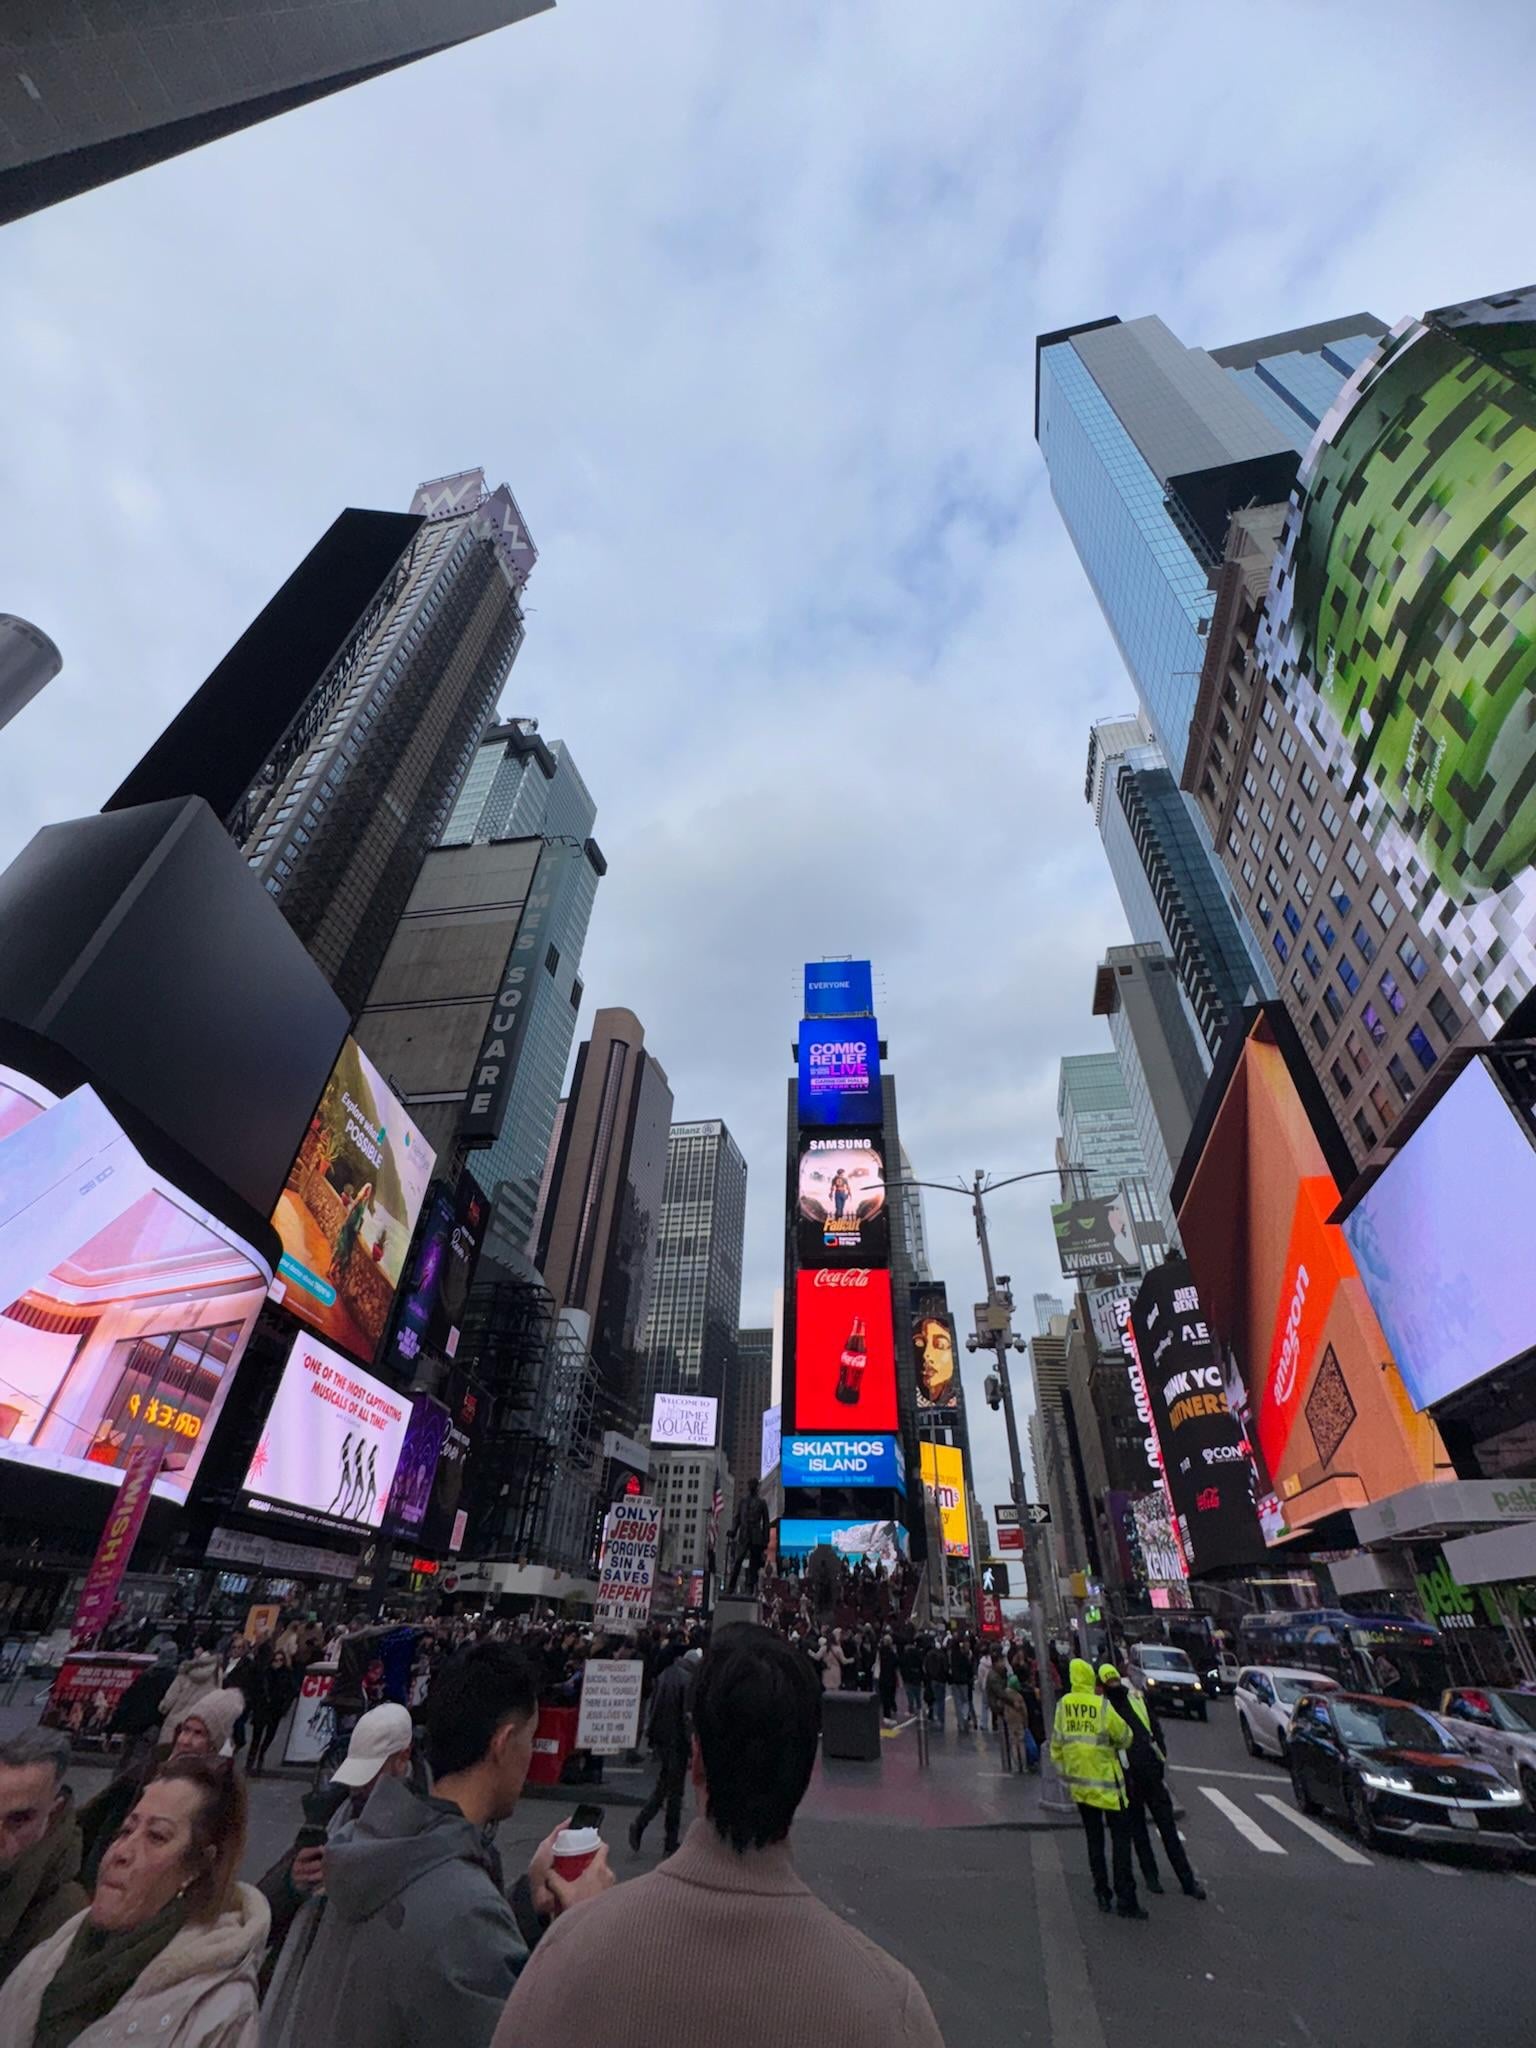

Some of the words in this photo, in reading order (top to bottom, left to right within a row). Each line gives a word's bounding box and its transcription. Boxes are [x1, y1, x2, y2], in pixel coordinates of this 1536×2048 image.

[517, 857, 559, 950] TIMES
[808, 981, 850, 990] EVERYONE
[470, 966, 527, 1114] SQUARE
[810, 1042, 867, 1055] COMIC
[810, 1053, 867, 1066] RELIEF
[830, 1064, 868, 1075] LIVE
[341, 1091, 366, 1125] Explore
[345, 1119, 383, 1170] POSSIBLE
[810, 1139, 872, 1150] SAMSUNG
[814, 1268, 872, 1288] Coca-Cola
[1096, 1287, 1127, 1308] LITTLE
[1273, 1264, 1310, 1406] amazon
[311, 1381, 348, 1410] MUSICALS
[348, 1401, 358, 1415] OF
[358, 1407, 369, 1422] ALL
[322, 1366, 333, 1381] OF
[333, 1372, 347, 1390] THE
[346, 1381, 366, 1400] MOST
[365, 1392, 402, 1422] CAPTIVATING
[680, 1409, 709, 1421] TIMES
[656, 1419, 709, 1437] SQUARE
[792, 1441, 884, 1456] SKIATHOS
[809, 1458, 867, 1472] ISLAND
[615, 1506, 659, 1522] ONLY
[610, 1520, 657, 1543] JESUS
[607, 1540, 657, 1559] FORGIVES
[610, 1556, 633, 1569] SIN
[637, 1560, 645, 1570] &
[603, 1569, 650, 1585] SAVES
[599, 1583, 652, 1603] REPENT
[615, 1605, 623, 1618] IS
[628, 1607, 648, 1620] NEAR
[1065, 1703, 1097, 1719] NYPD
